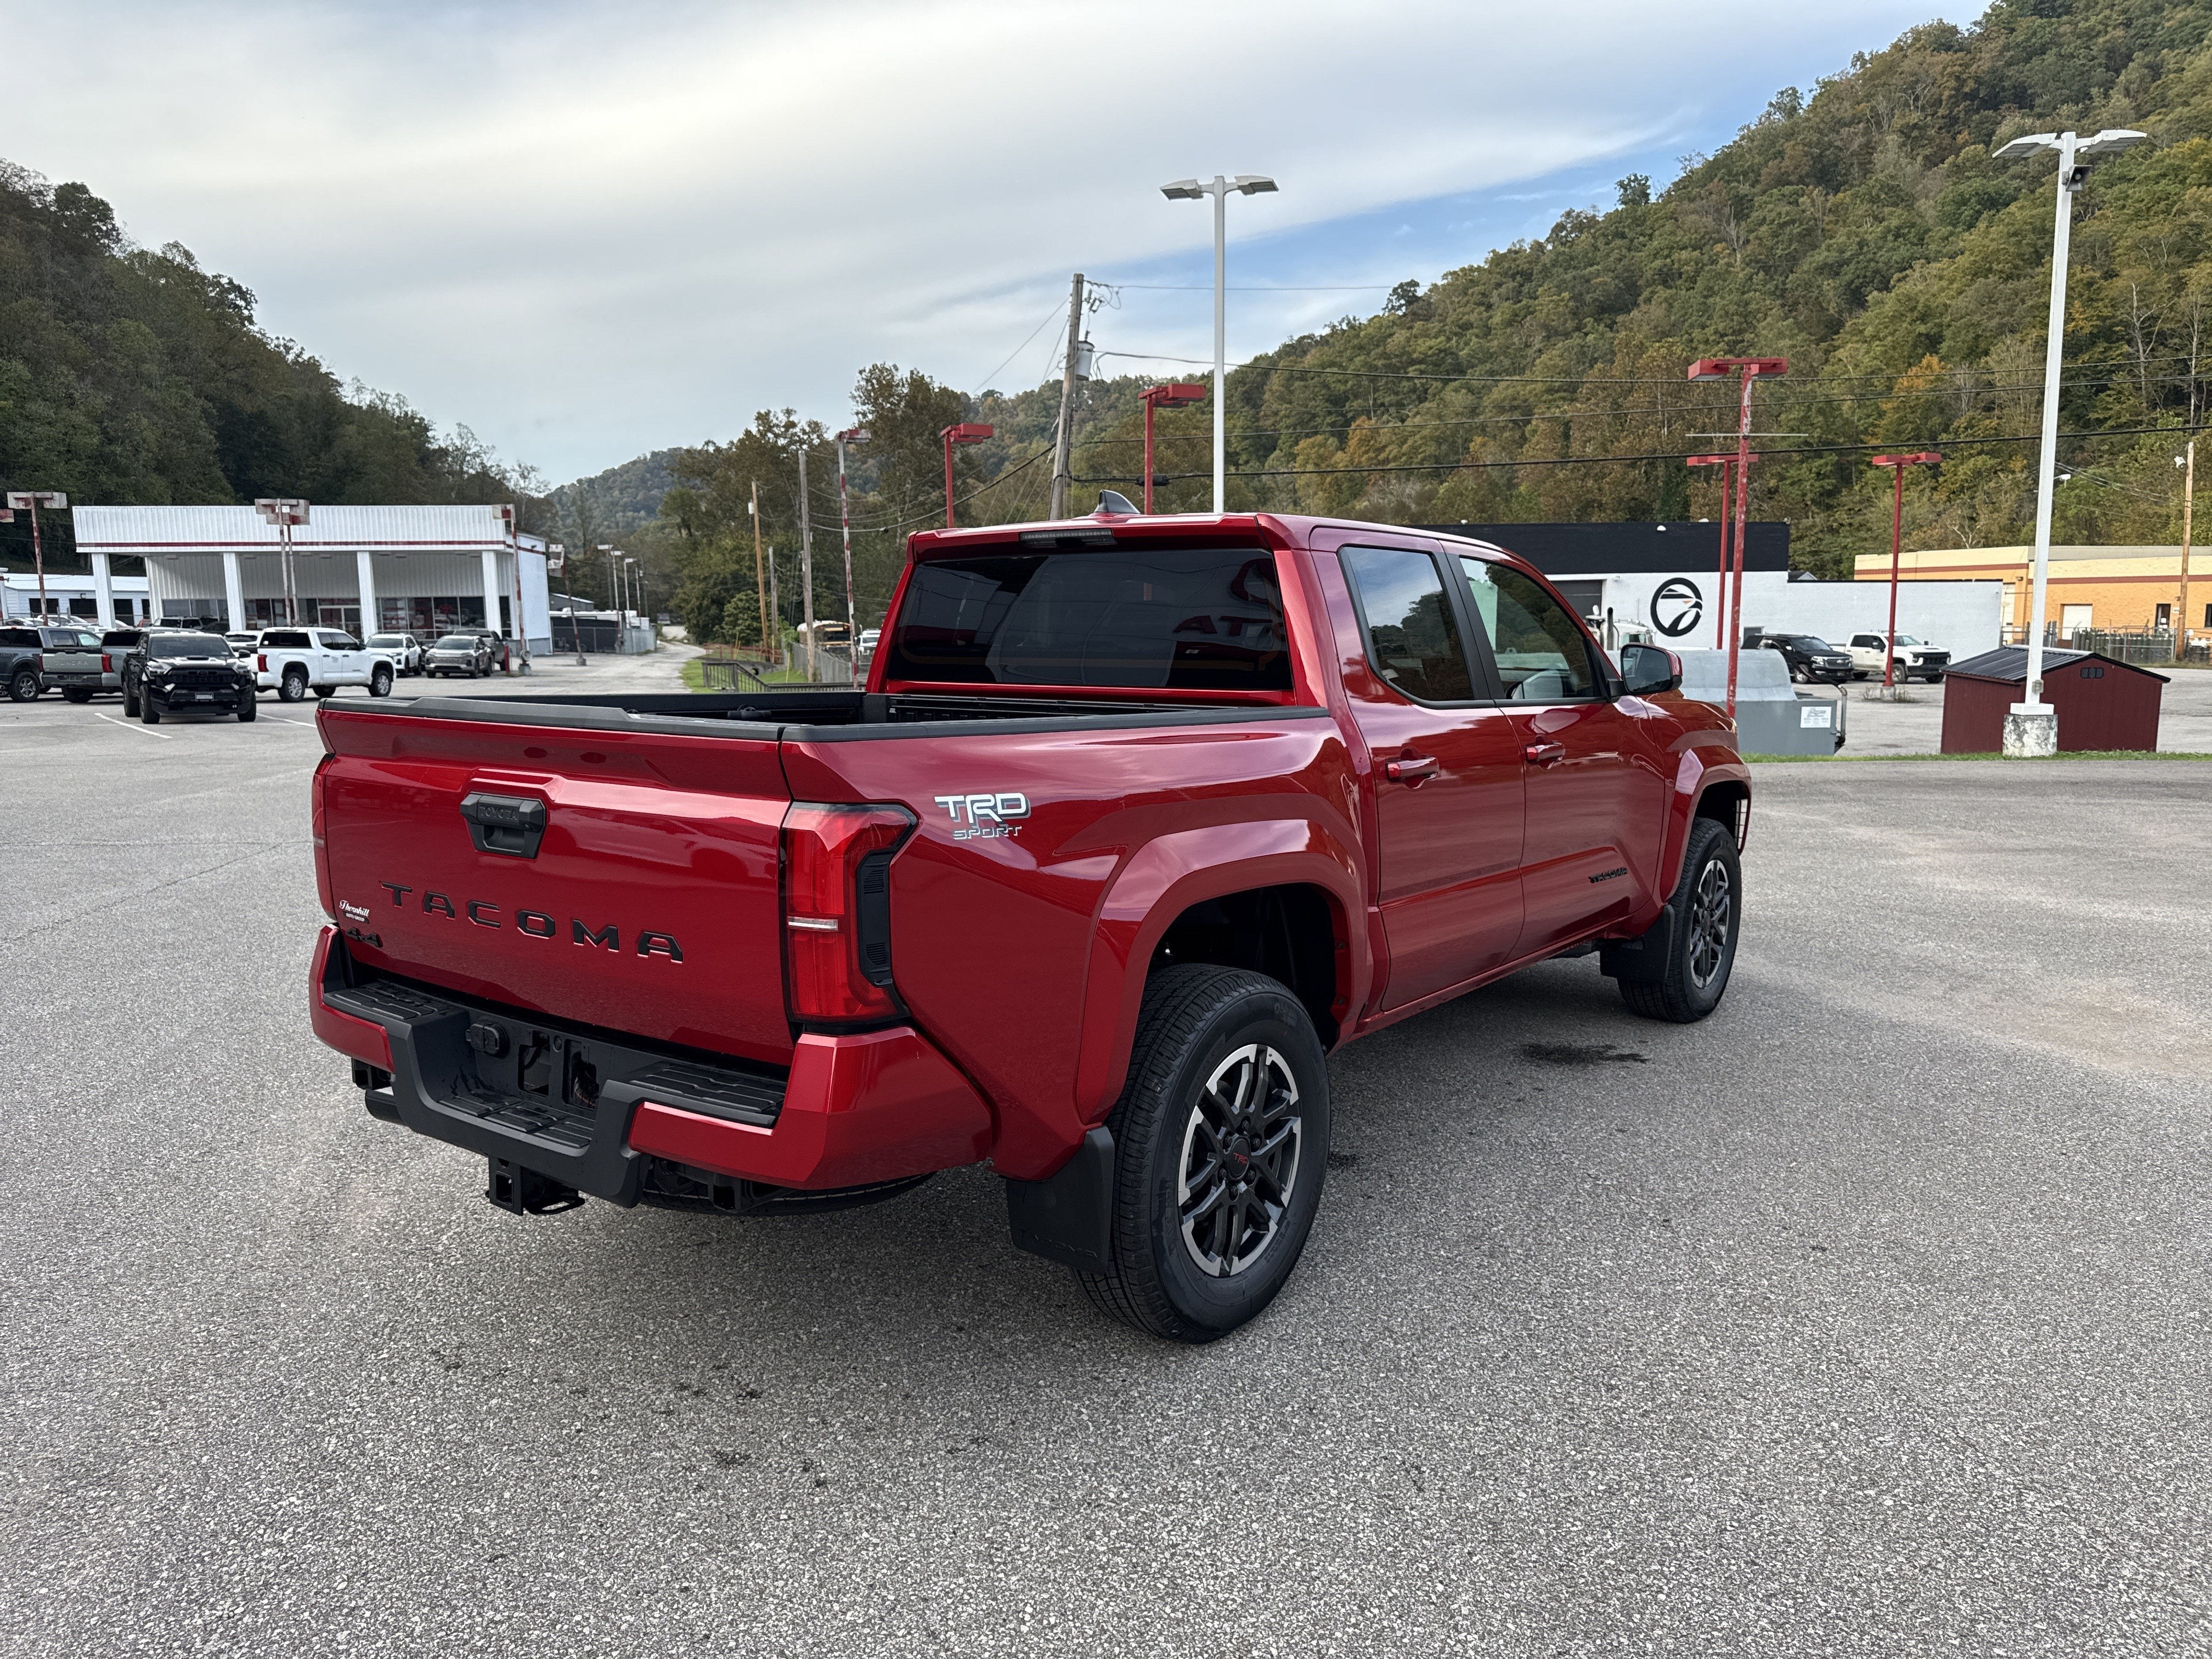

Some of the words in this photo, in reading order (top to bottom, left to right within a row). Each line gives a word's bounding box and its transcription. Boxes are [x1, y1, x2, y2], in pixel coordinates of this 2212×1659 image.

[479, 806, 518, 821] TOYOTA
[934, 792, 1031, 827] TRD
[952, 825, 1022, 840] SPORT
[1588, 867, 1628, 884] TACOMA
[339, 899, 370, 917] Thornhill
[381, 881, 684, 964] TACOMA
[1233, 1152, 1249, 1166] TRD
